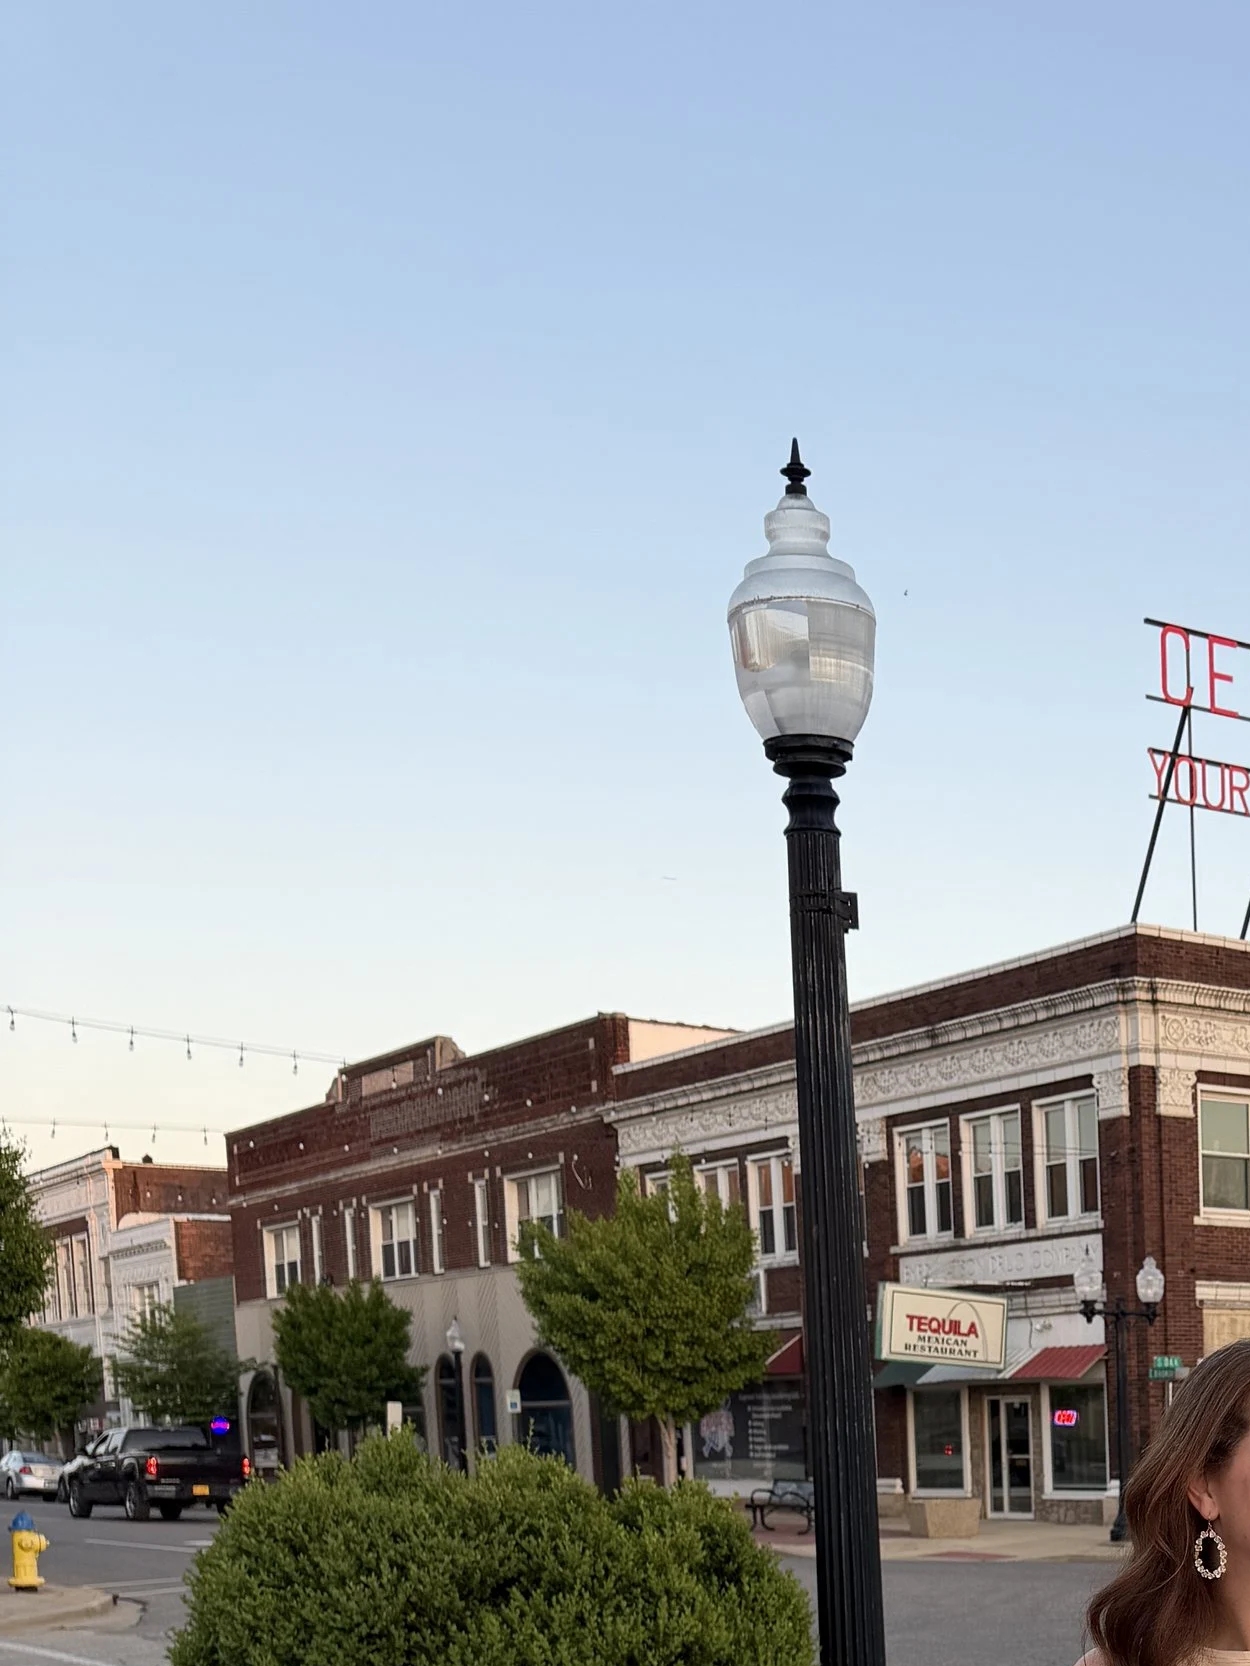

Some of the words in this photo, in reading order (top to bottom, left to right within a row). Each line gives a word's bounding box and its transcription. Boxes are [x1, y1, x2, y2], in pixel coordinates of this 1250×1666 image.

[1147, 748, 1250, 816] YOUR
[906, 1314, 979, 1338] TEQUILA
[917, 1334, 968, 1347] MEXICAN
[905, 1343, 978, 1358] RESTAURANT
